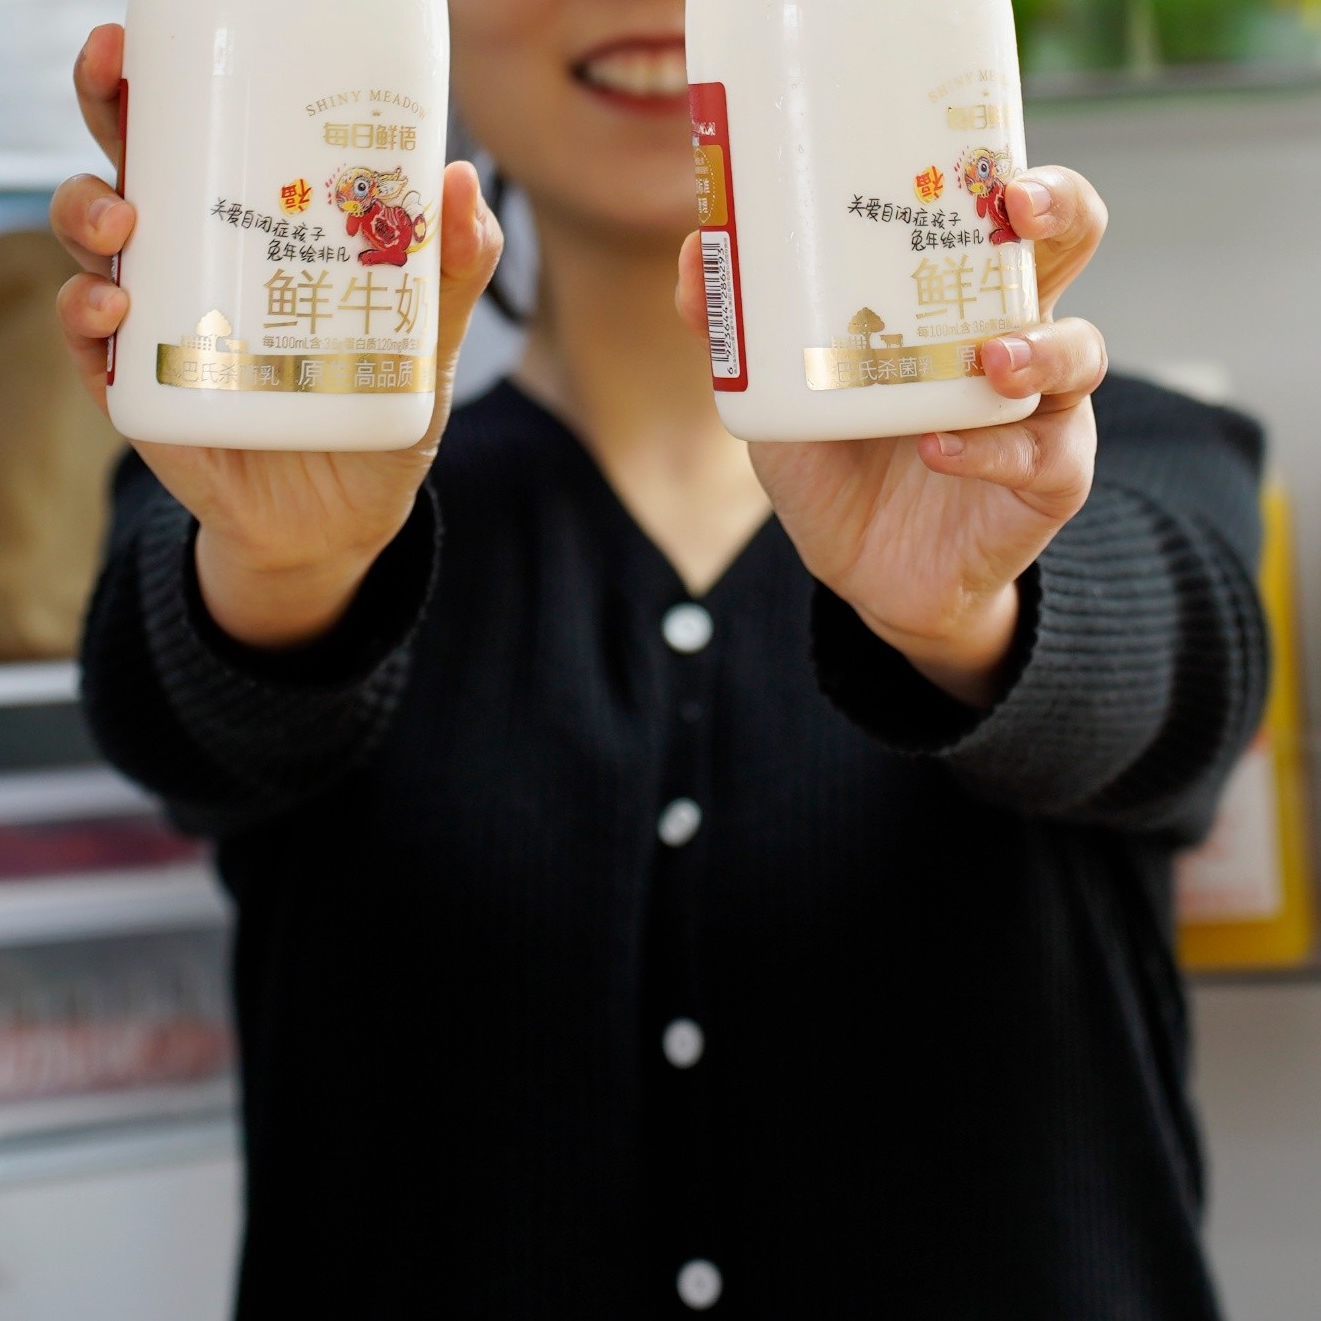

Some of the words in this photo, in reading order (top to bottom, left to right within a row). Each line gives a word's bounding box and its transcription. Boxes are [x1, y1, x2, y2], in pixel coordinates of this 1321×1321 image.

[305, 90, 361, 117] SHINY
[323, 122, 417, 151] 每日鲜语
[211, 197, 326, 243] 关爱自闭症孩子
[847, 194, 961, 230] 关爱自闭症孩子
[263, 269, 430, 335] 鲜牛奶
[837, 356, 936, 383] 巴氏杀菌乳
